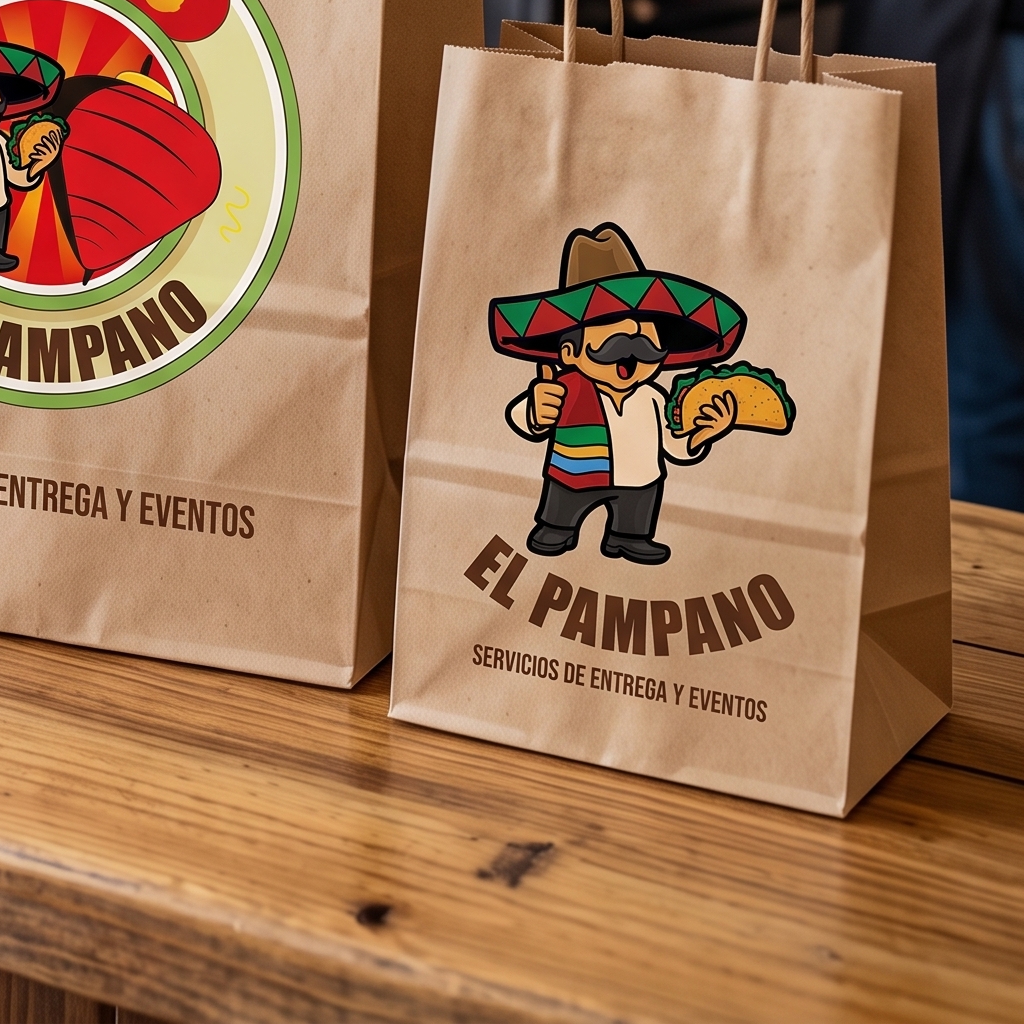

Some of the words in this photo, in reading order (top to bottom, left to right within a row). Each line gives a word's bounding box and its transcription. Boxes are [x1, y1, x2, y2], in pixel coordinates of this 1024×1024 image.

[115, 487, 133, 522] Y
[139, 491, 255, 539] EVENTOS
[463, 534, 529, 610] EL
[528, 572, 795, 657] PAMPANO
[472, 643, 559, 681] SERVICIOS
[563, 662, 585, 687] DE
[590, 667, 667, 704] ENTREGA
[673, 683, 685, 706] Y
[688, 686, 768, 723] EVENTOS
